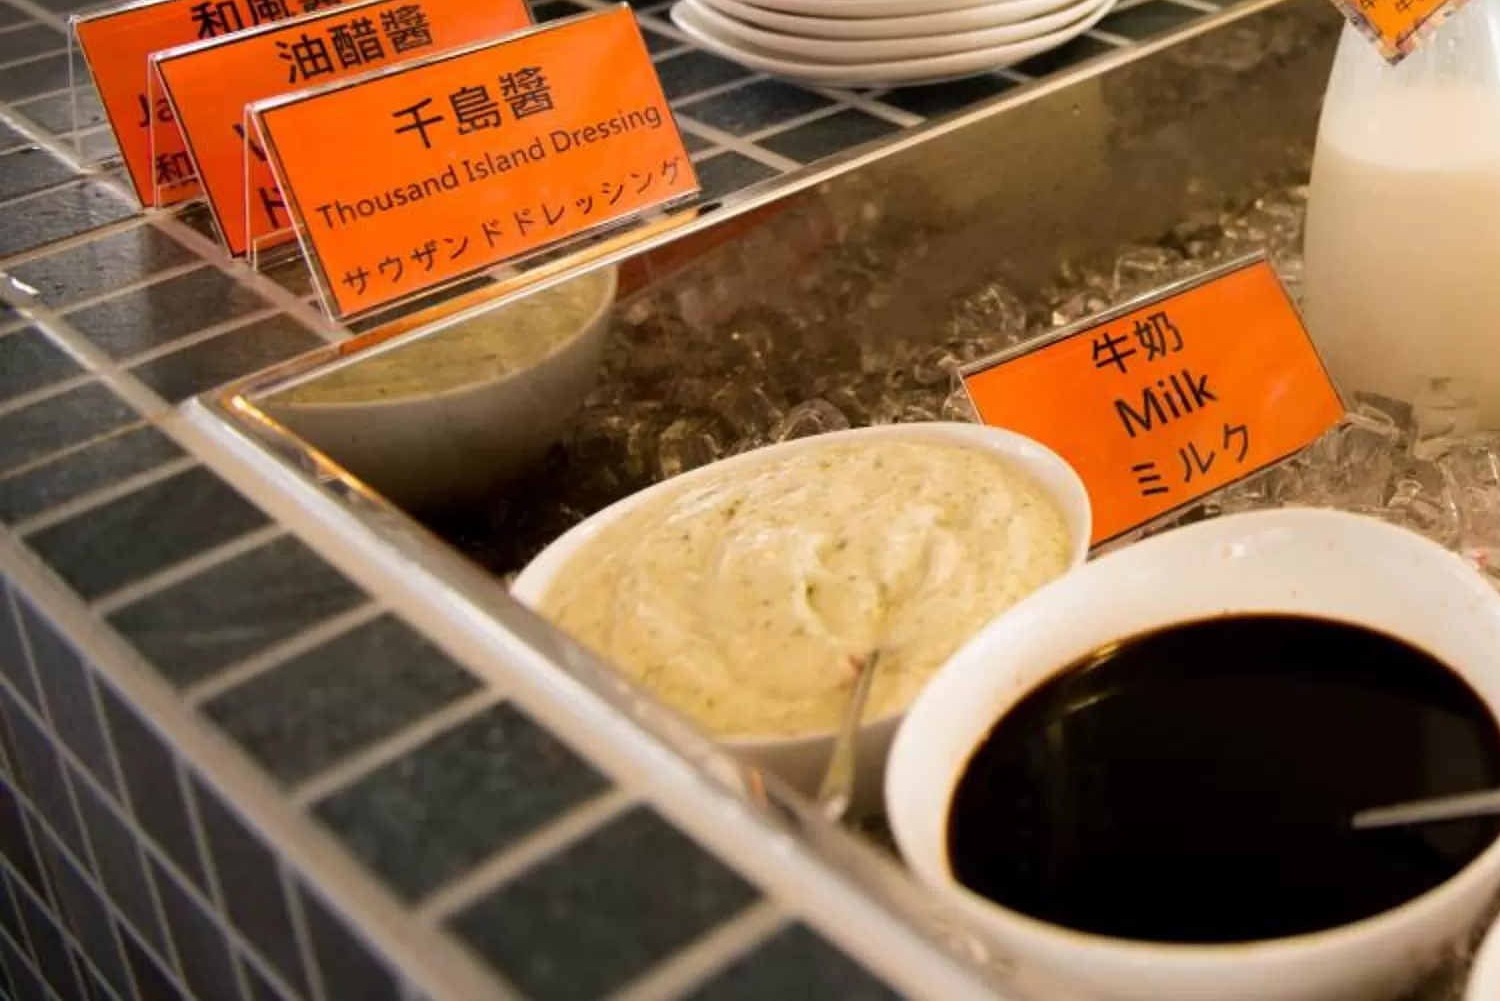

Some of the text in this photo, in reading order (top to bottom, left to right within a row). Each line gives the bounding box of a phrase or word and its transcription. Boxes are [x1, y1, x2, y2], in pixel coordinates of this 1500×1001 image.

[275, 4, 432, 83] 油醋醬
[392, 66, 554, 149] 千島醬
[315, 164, 459, 230] Thousand
[463, 136, 546, 183] Island
[550, 106, 662, 154] Dressing
[1091, 311, 1183, 373] 牛奶
[1114, 369, 1219, 439] Milk
[1131, 422, 1249, 497] ミルク
